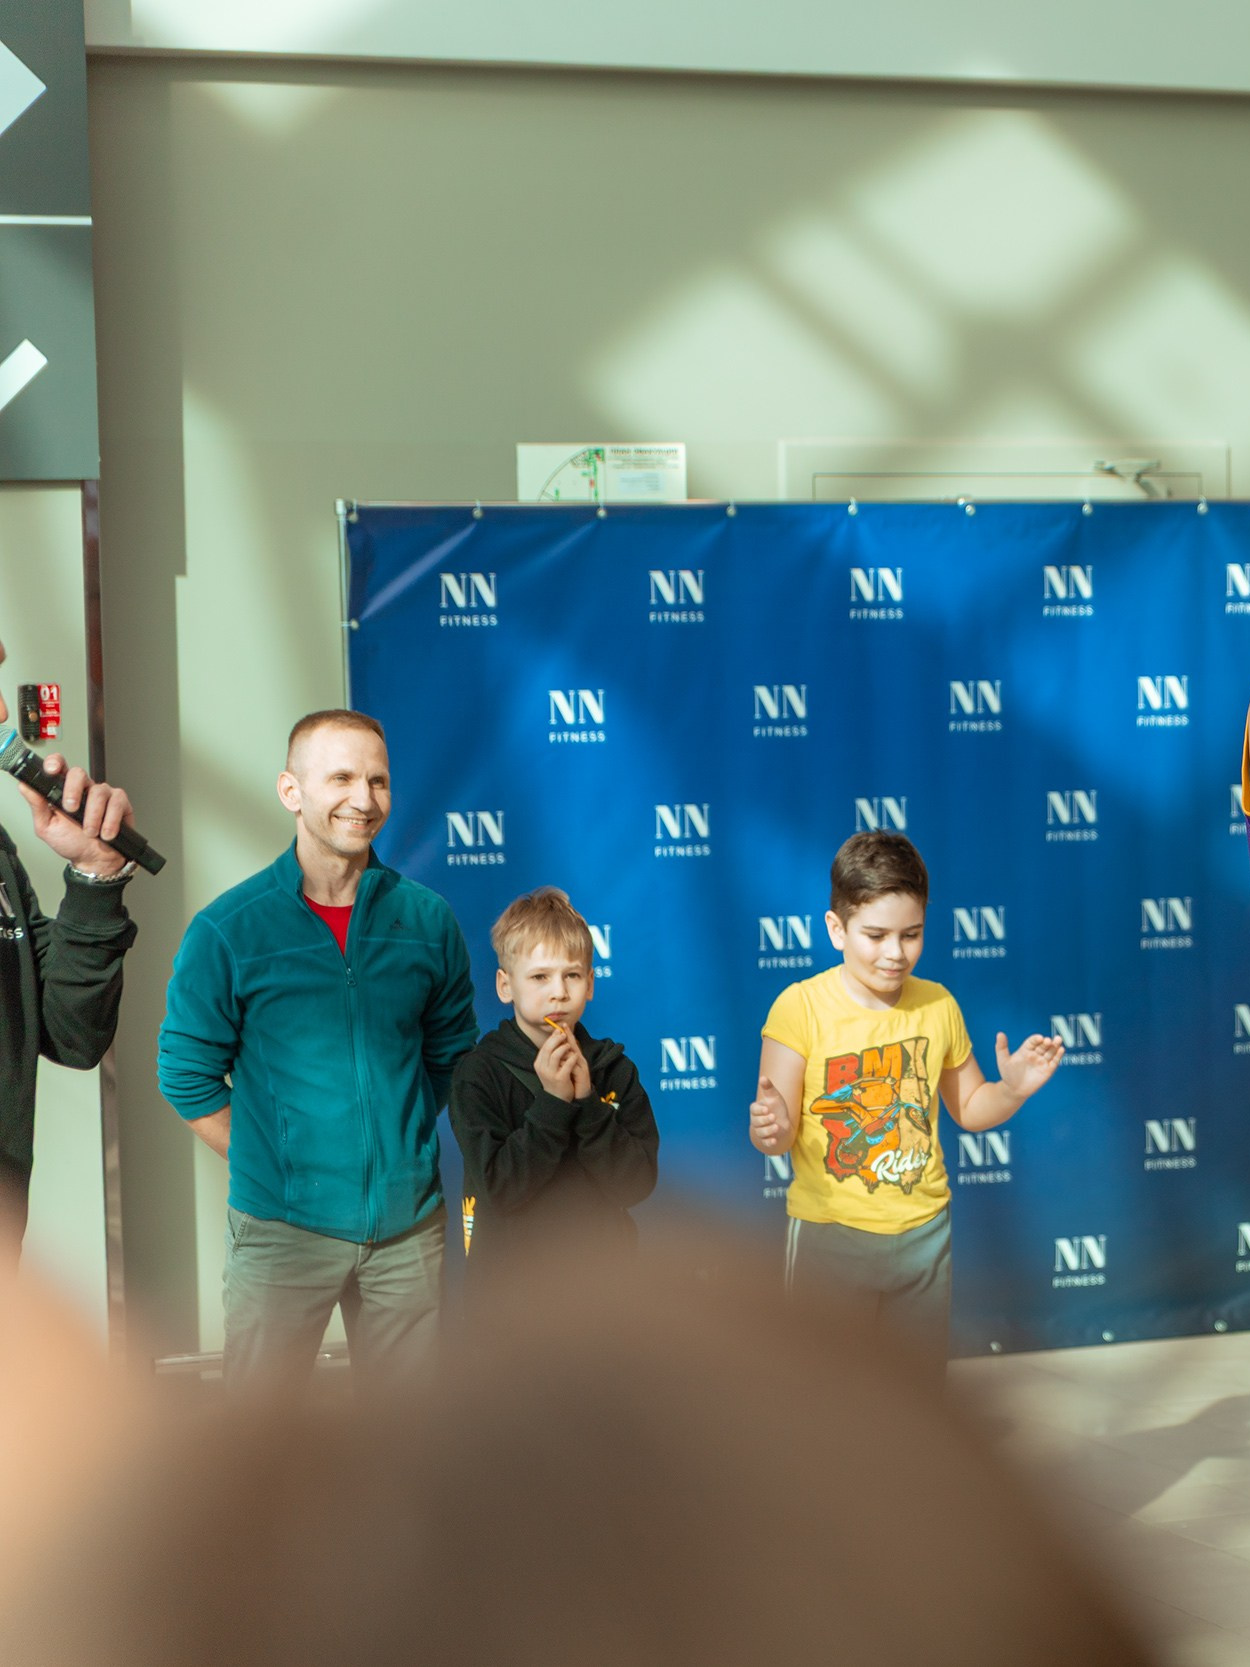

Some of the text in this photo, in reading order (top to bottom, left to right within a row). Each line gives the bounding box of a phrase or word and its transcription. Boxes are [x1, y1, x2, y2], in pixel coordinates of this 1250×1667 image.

[441, 573, 496, 607] NN
[650, 570, 703, 604] NN
[851, 568, 902, 601] NN
[1044, 565, 1092, 598] NN
[440, 614, 497, 626] FITNESS
[649, 611, 704, 622] FITNESS
[850, 608, 903, 619] FITNESS
[1043, 605, 1093, 616] FITNESS
[40, 684, 58, 701] 01
[549, 689, 604, 724] NN
[754, 685, 806, 719] NN
[950, 680, 1001, 714] NN
[1138, 676, 1188, 709] NN
[549, 731, 605, 742] FITNESS
[753, 725, 807, 736] FITNESS
[949, 720, 1002, 731] FITNESS
[1137, 715, 1189, 726] FITNESS
[656, 804, 709, 839] NN
[855, 797, 907, 832] NN
[1047, 790, 1097, 824] NN
[447, 811, 503, 847] NN
[1046, 829, 1098, 841] FITNESS
[447, 852, 505, 865] FITNESS
[655, 845, 710, 857] FITNESS
[954, 907, 1005, 941] NN
[1142, 897, 1192, 931] NN
[588, 924, 611, 959] N
[760, 915, 811, 950] NN
[1140, 936, 1193, 949] FITNESS
[758, 956, 813, 968] FITNESS
[953, 947, 1006, 958] FITNESS
[1050, 1013, 1102, 1048] NN
[661, 1036, 715, 1072] NN
[1059, 1052, 1103, 1066] TNESS
[660, 1077, 716, 1090] FITNESS
[958, 1131, 1011, 1167] NN
[1146, 1119, 1195, 1153] NN
[870, 1147, 930, 1182] Rider
[958, 1170, 1011, 1184] FITNESS
[1144, 1156, 1196, 1170] FITNESS
[1055, 1235, 1106, 1271] NN
[1052, 1274, 1105, 1288] FITNESS
